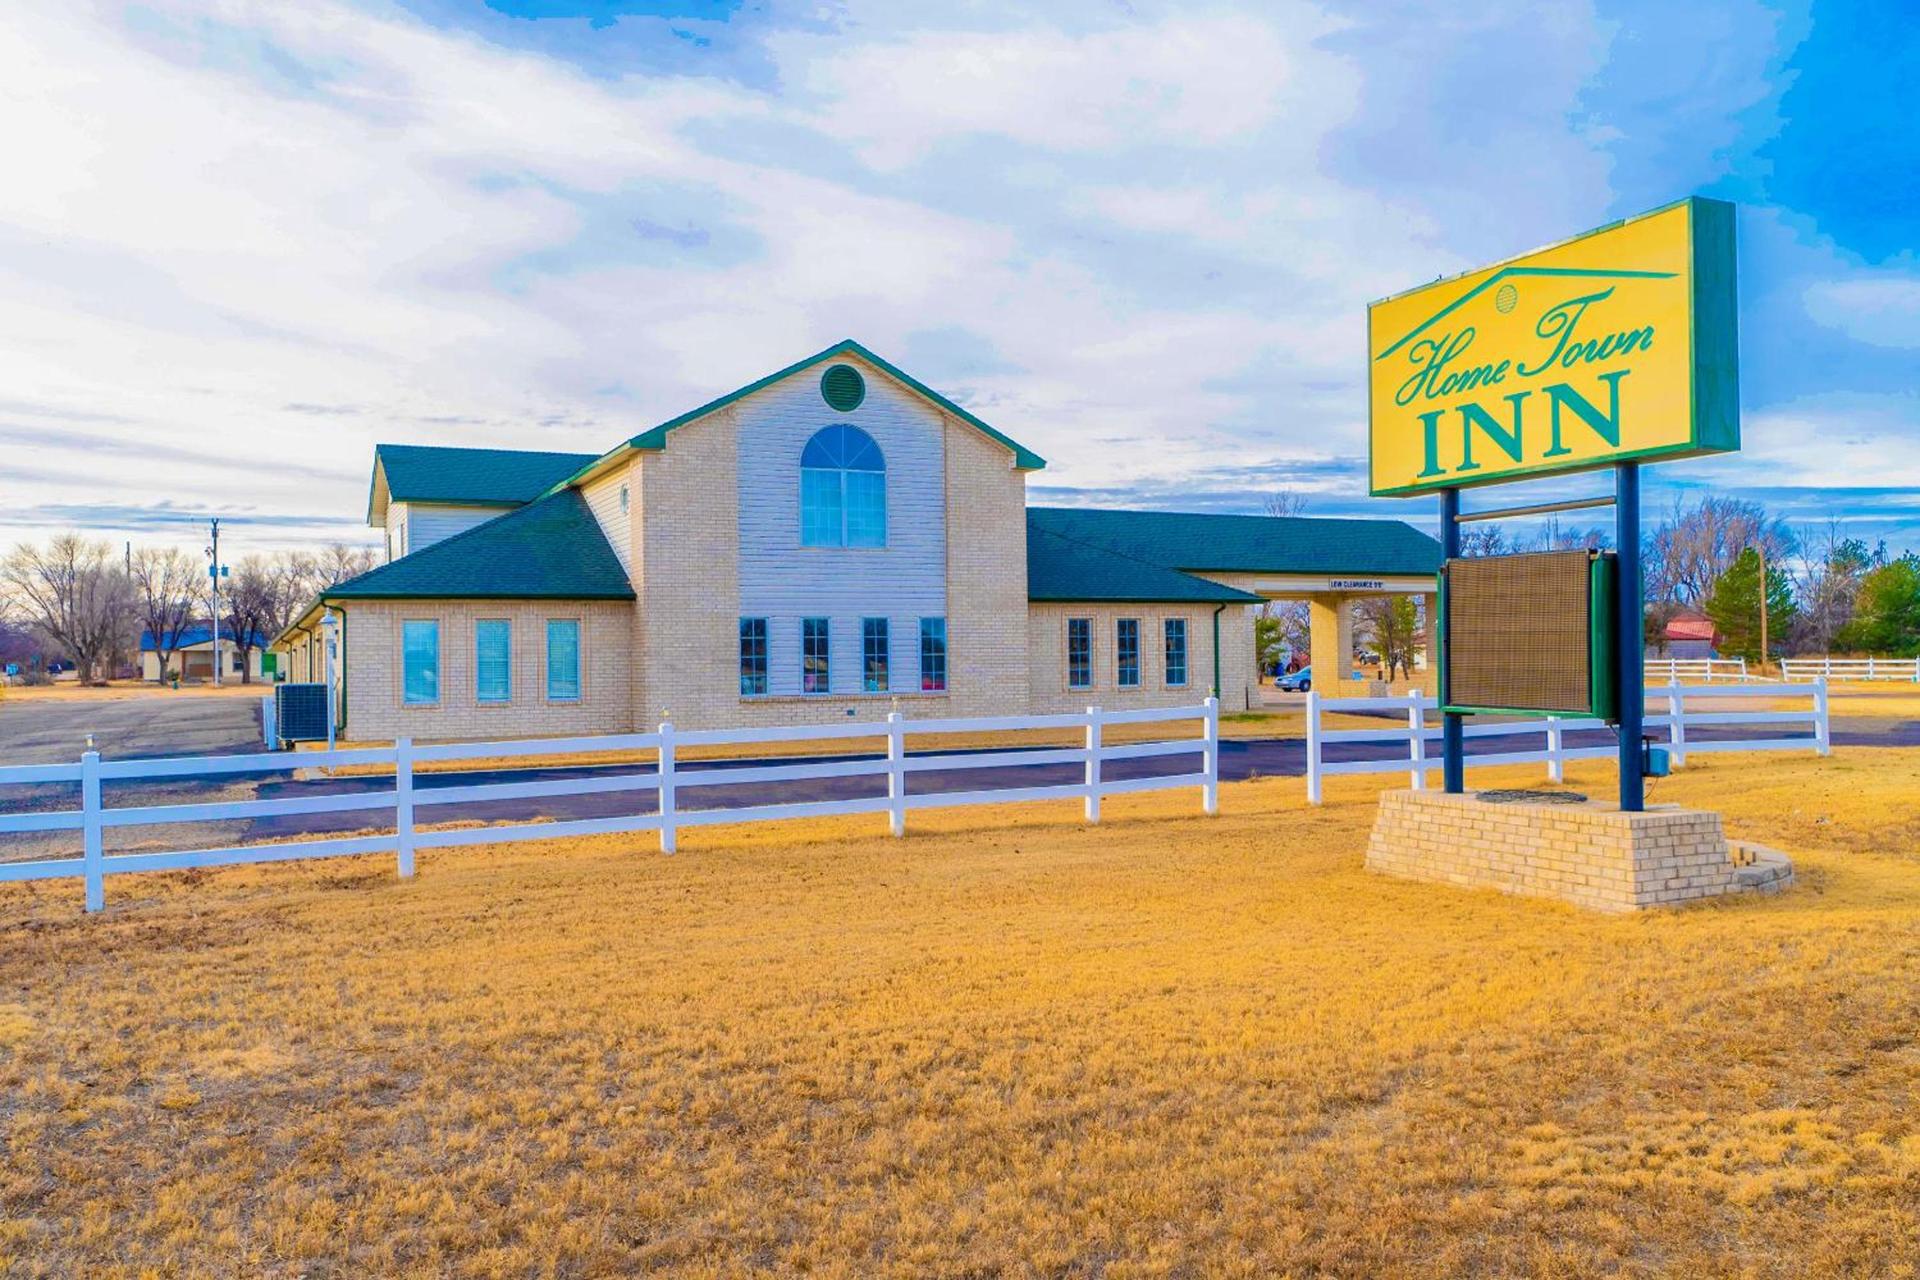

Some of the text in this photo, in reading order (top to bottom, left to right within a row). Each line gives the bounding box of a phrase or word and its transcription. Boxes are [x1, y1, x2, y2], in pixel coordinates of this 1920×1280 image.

[1395, 286, 1654, 407] Home Town
[1416, 369, 1631, 478] INN
[1343, 580, 1373, 588] CLEARANCE
